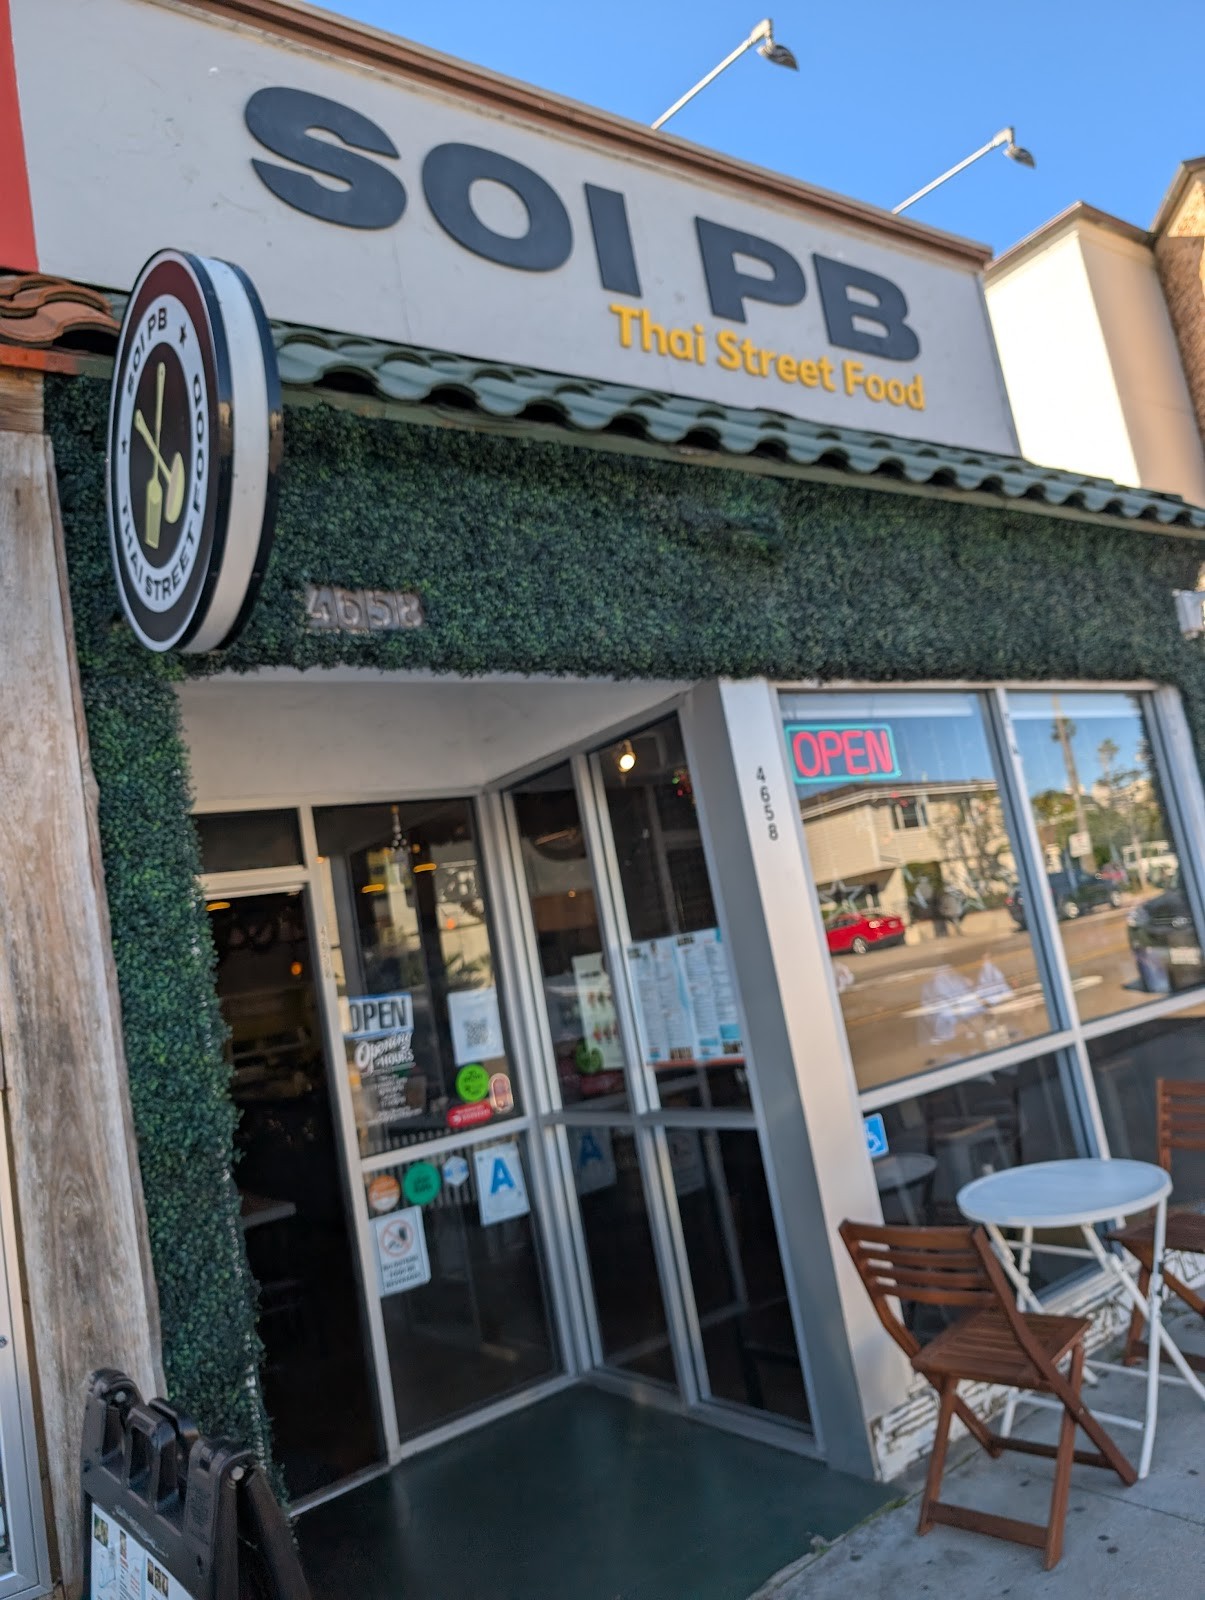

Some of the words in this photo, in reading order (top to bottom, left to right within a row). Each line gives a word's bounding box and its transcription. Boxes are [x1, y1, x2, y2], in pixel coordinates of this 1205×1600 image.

[245, 86, 641, 297] SOI
[695, 216, 921, 361] PB
[127, 331, 146, 398] SOI
[148, 307, 167, 340] PB
[610, 304, 706, 365] Thai
[717, 329, 836, 391] Street
[842, 360, 925, 411] Food
[121, 497, 144, 584] THAI
[145, 520, 194, 600] STREET
[193, 373, 204, 513] FOOD
[308, 587, 422, 627] 4658
[792, 730, 893, 777] OPEN
[756, 766, 778, 841] 4658
[349, 998, 408, 1033] OPEN
[490, 1157, 516, 1195] A
